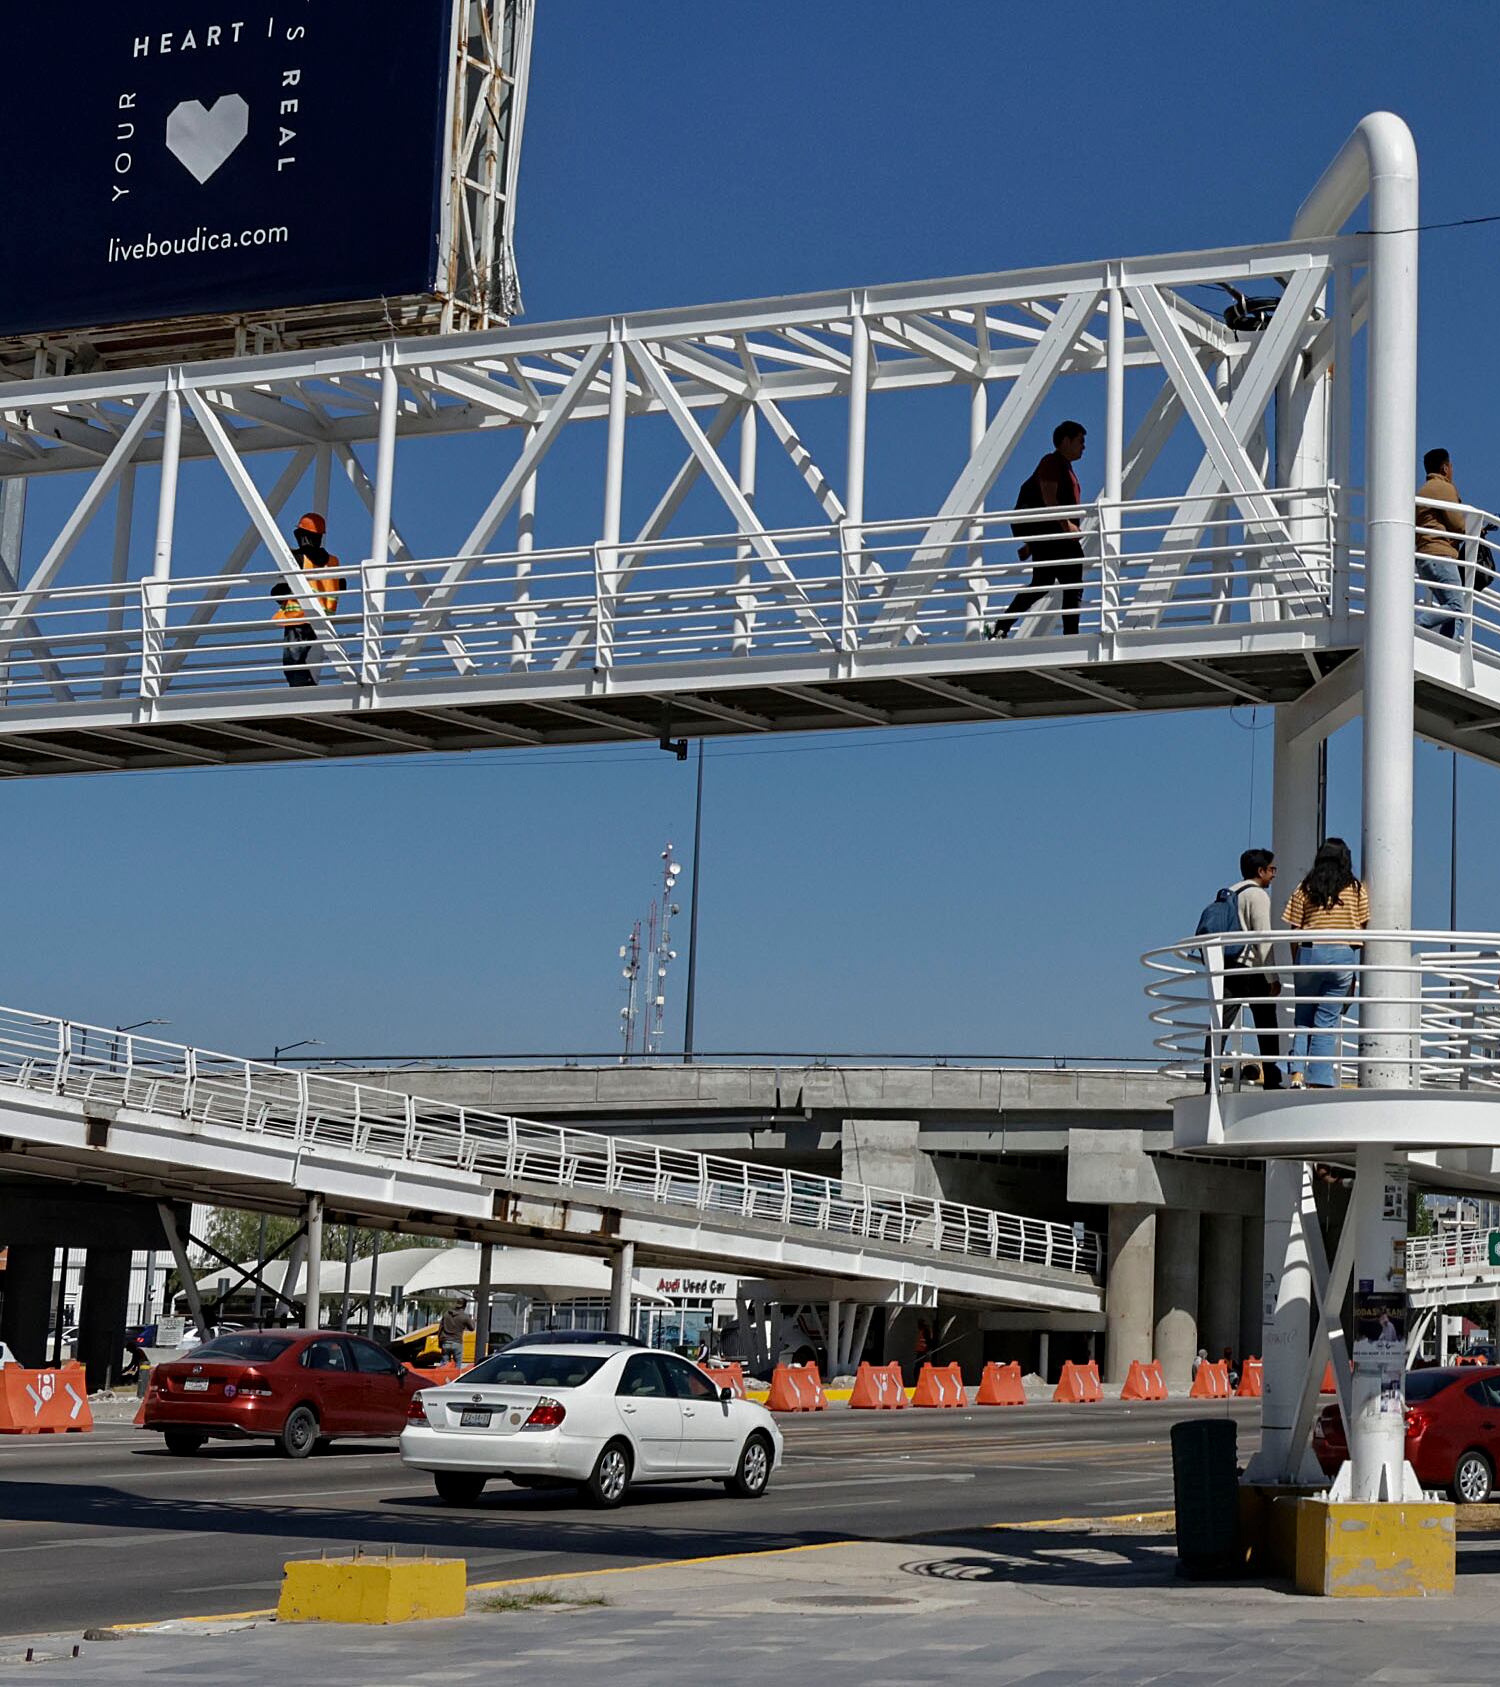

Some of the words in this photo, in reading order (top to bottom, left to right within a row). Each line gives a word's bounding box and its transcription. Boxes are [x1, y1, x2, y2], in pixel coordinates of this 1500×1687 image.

[133, 22, 244, 58] HEART
[267, 17, 305, 41] IS
[278, 69, 301, 172] REAL
[112, 92, 136, 202] YOUR
[108, 226, 289, 263] liveboudica.com
[657, 1278, 680, 1293] Audi
[683, 1279, 708, 1294] Used
[710, 1280, 726, 1294] Car
